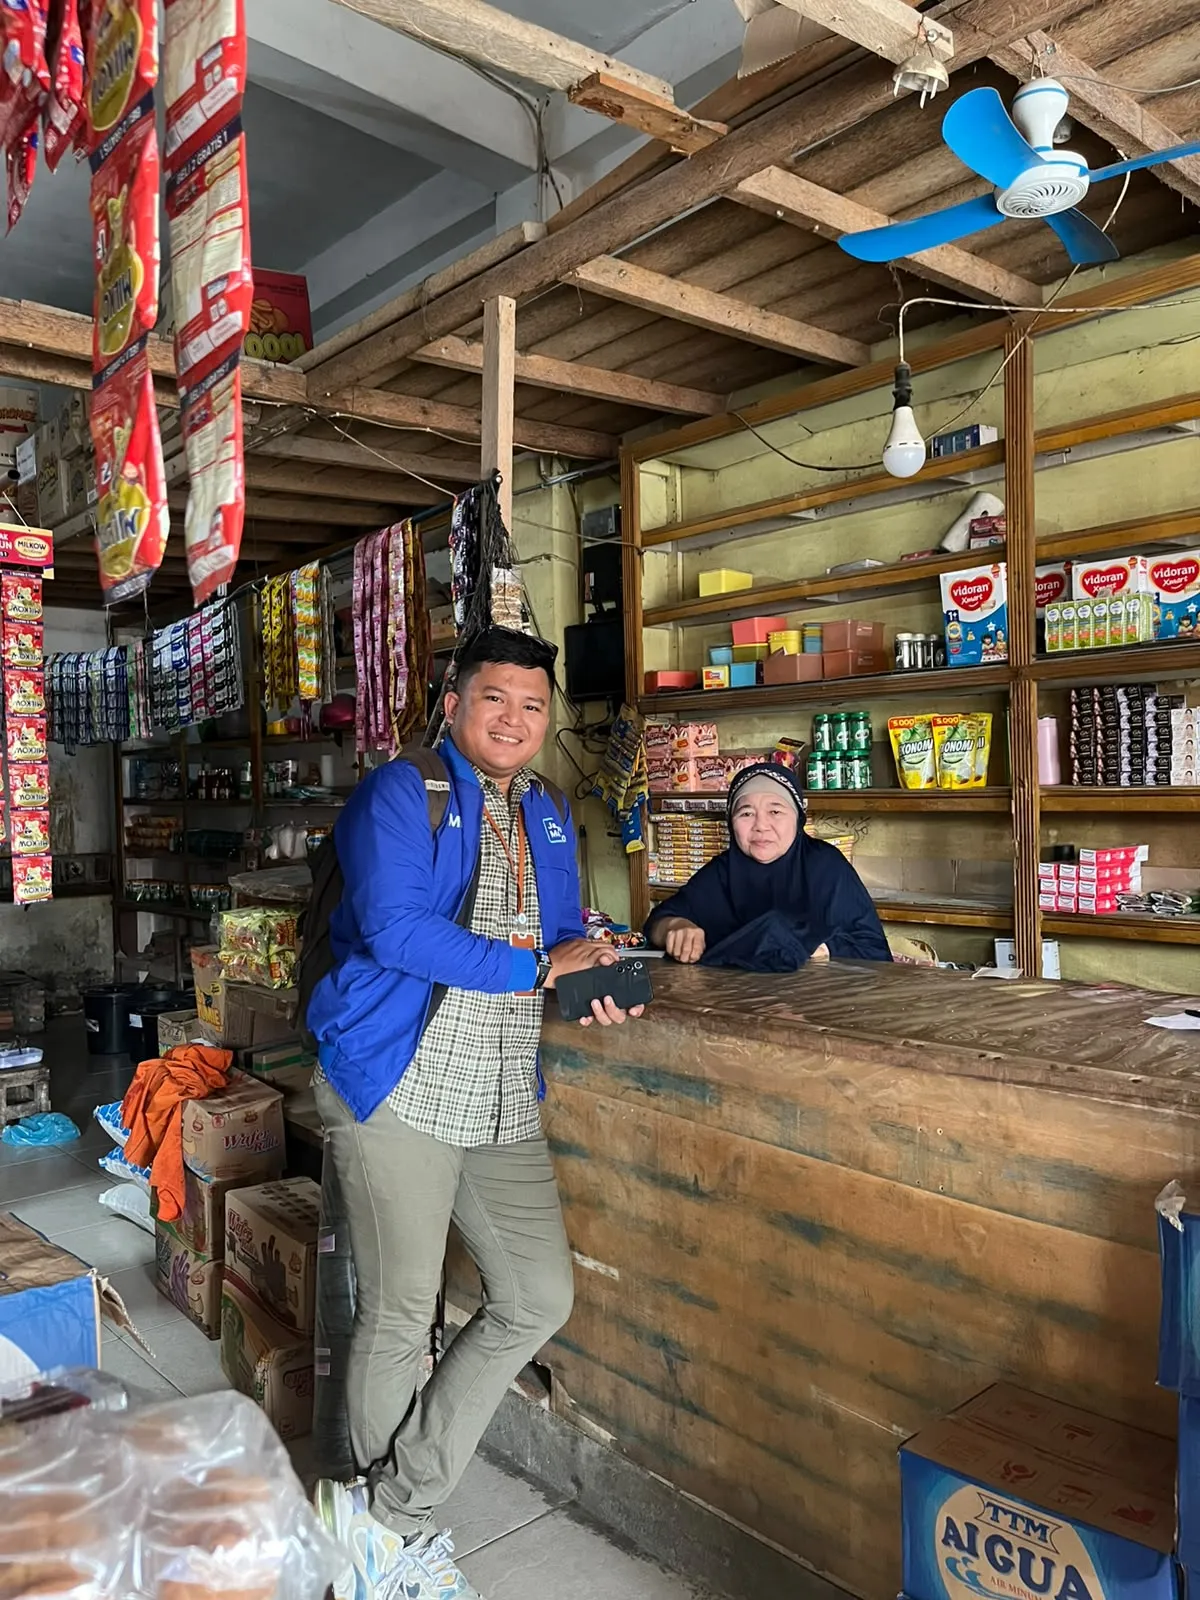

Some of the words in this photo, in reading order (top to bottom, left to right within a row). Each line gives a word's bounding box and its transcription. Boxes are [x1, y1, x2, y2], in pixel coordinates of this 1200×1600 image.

[17, 540, 47, 550] MILKOW
[1084, 572, 1124, 586] vidoran
[1153, 565, 1195, 579] vidoran
[1163, 576, 1188, 587] Xmart
[952, 583, 989, 597] vidoran
[223, 1129, 270, 1150] Wafer
[985, 1501, 1051, 1544] TTM
[942, 1515, 1093, 1600] AIGUA
[990, 1575, 1008, 1589] AIR
